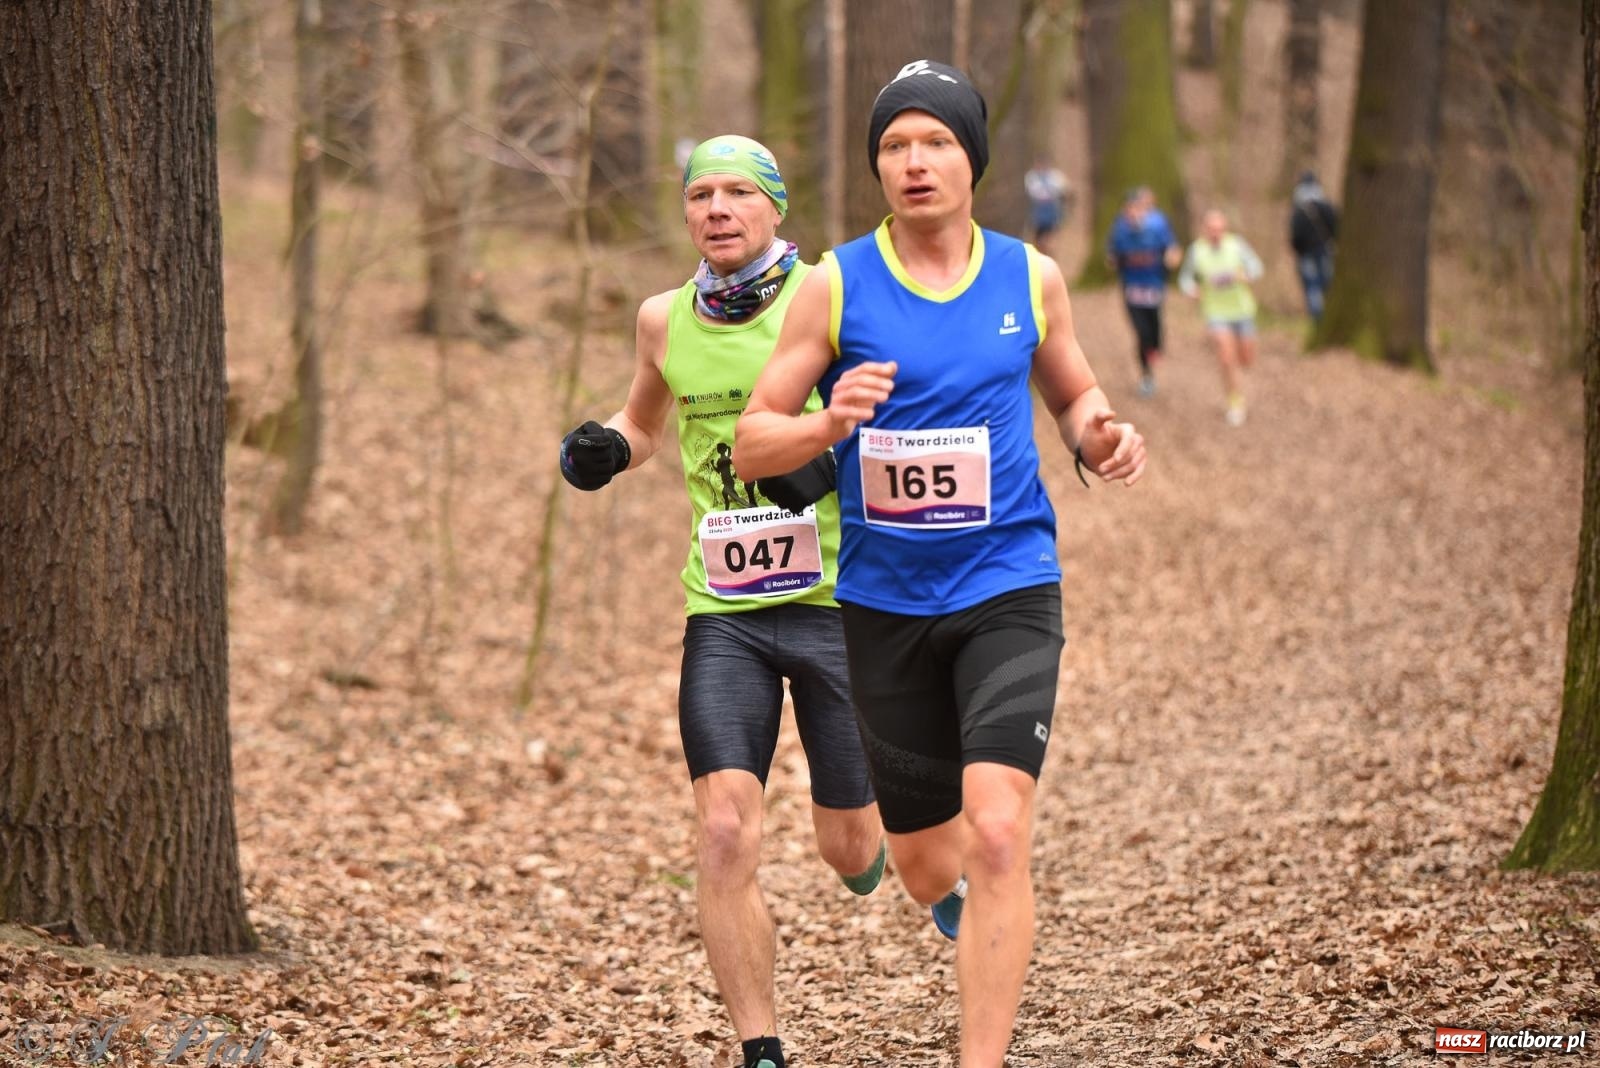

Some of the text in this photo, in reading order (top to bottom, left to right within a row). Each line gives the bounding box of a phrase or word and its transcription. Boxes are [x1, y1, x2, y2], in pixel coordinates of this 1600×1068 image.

[868, 434, 975, 447] BIEG Twardziela
[885, 464, 957, 500] 165
[707, 516, 732, 528] BIEG
[724, 535, 795, 573] 047
[772, 578, 801, 588] Racibórz
